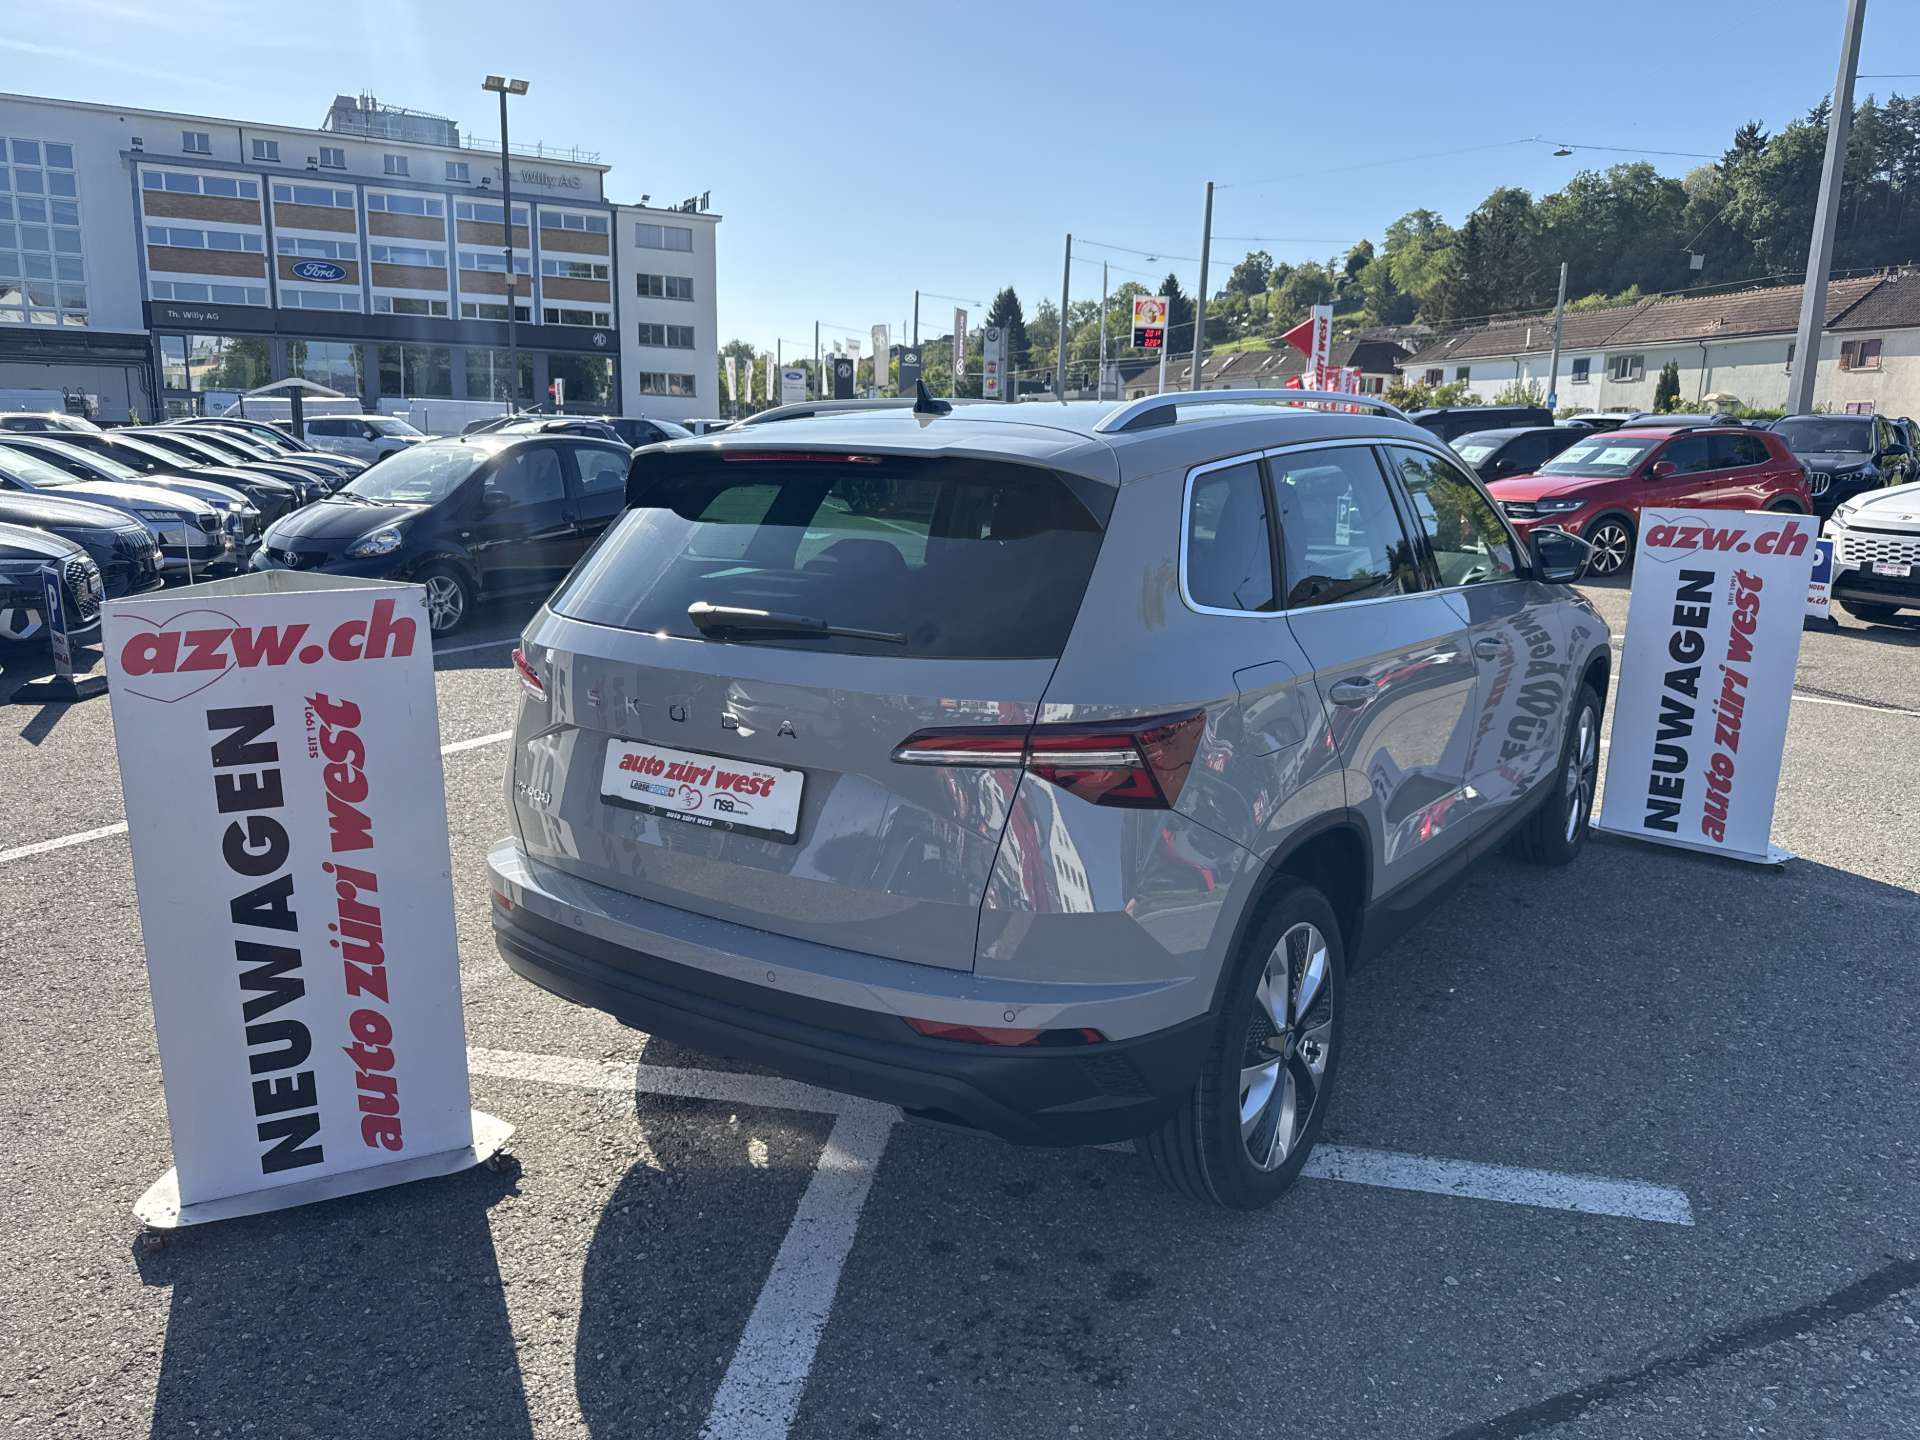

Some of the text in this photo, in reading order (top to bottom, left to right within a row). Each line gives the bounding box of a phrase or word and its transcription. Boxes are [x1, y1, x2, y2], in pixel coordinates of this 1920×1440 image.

[521, 168, 556, 189] Willy
[558, 175, 582, 190] AG
[303, 263, 336, 278] Ford
[168, 309, 220, 321] Th. Willy AG
[593, 332, 607, 346] MG
[1645, 521, 1809, 557] azw.ch
[48, 583, 58, 623] P
[1807, 596, 1828, 605] w.ch
[121, 599, 417, 677] azw.ch
[587, 688, 797, 740] SKODA
[1644, 569, 1716, 833] NEUWAGEN
[1702, 568, 1763, 843] auto züri west
[304, 706, 319, 759] SEIT 1991
[618, 753, 776, 798] auto züri west
[666, 811, 681, 820] auto
[697, 817, 713, 827] west
[714, 796, 733, 812] nsa
[206, 704, 325, 1174] NEUWAGEN
[304, 692, 404, 1152] auto züri west
